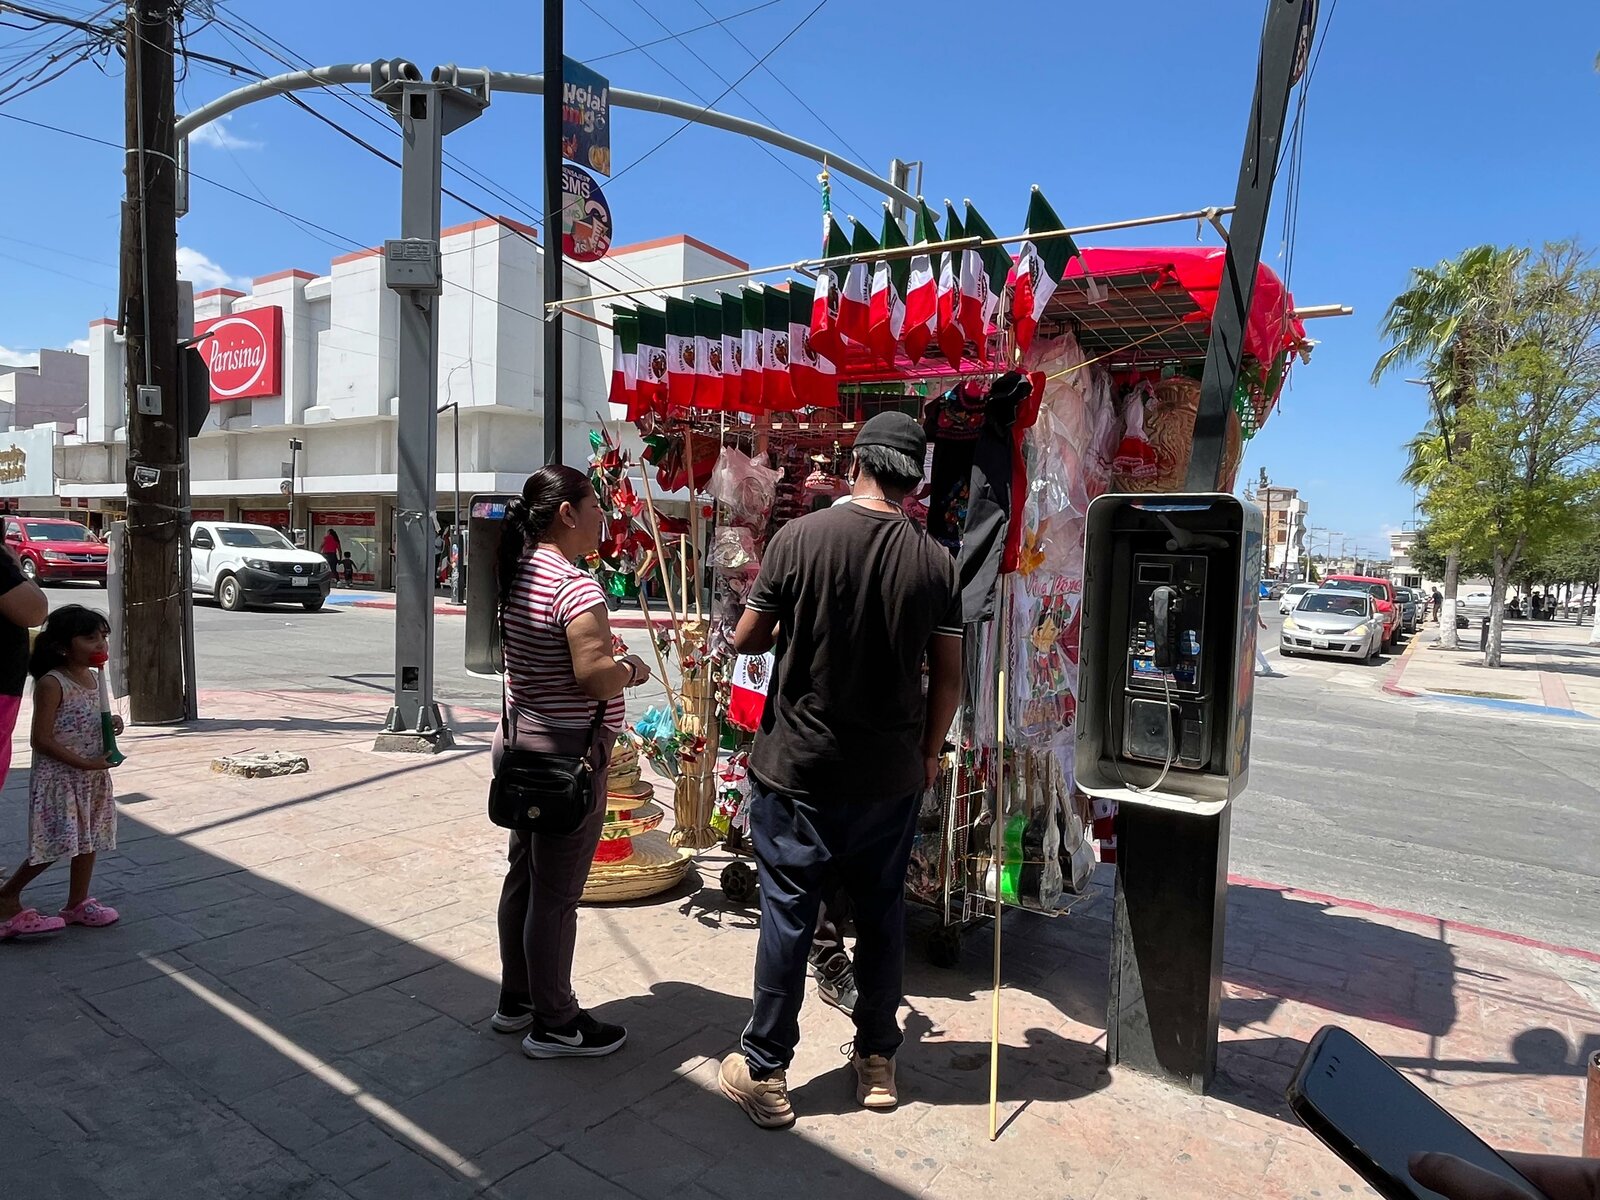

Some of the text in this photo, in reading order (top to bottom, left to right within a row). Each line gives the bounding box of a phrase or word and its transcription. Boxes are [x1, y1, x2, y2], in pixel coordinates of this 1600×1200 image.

[562, 173, 591, 199] SMS
[209, 339, 261, 373] Parisina
[602, 827, 631, 839] VA
